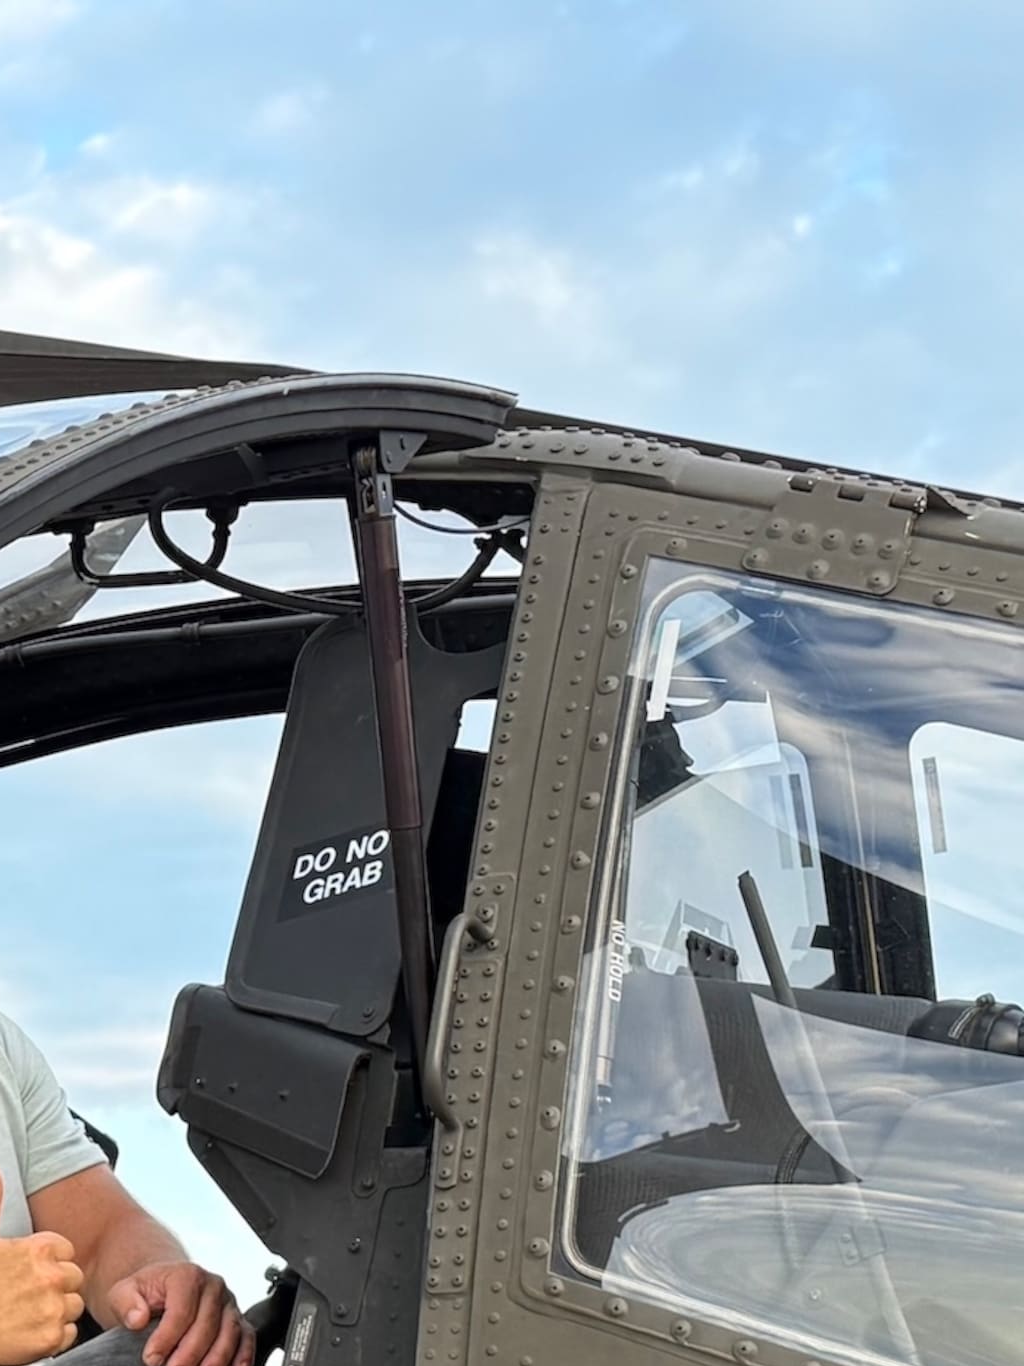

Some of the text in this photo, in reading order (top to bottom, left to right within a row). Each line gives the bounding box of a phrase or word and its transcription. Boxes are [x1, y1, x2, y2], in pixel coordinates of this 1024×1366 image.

[293, 830, 392, 880] DO NO
[303, 860, 383, 904] GRAB
[609, 920, 625, 1002] NO HOLD
